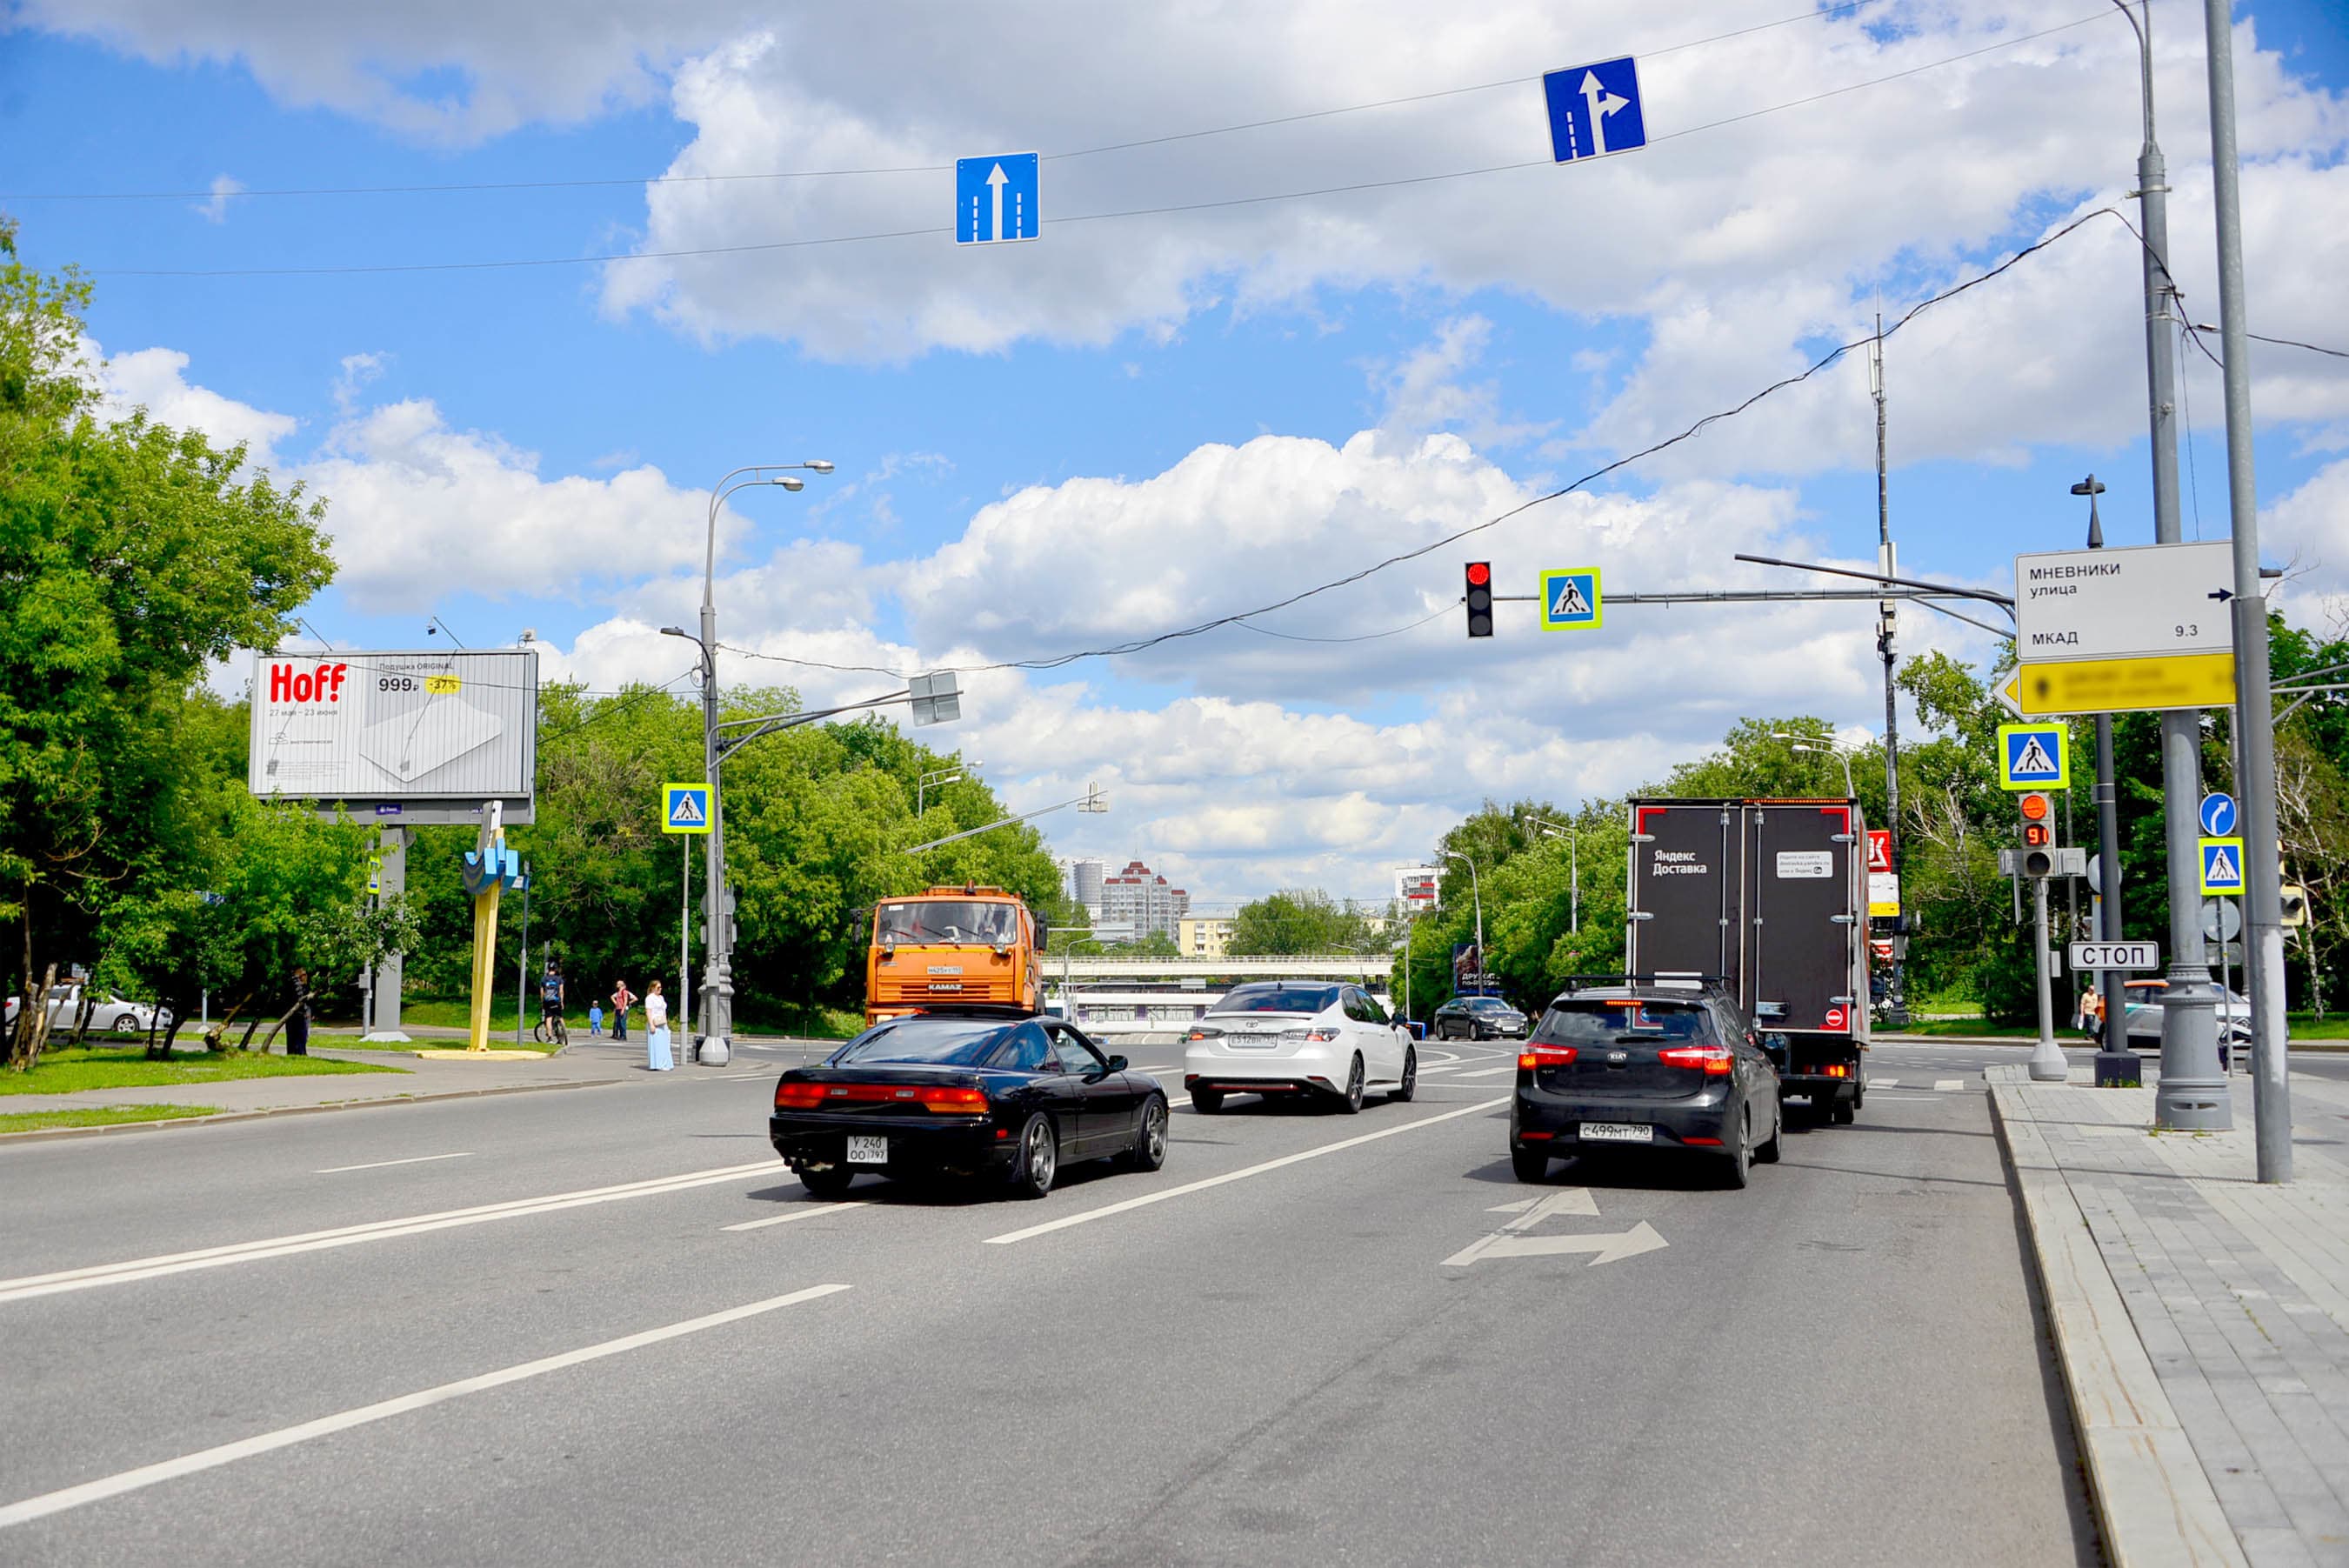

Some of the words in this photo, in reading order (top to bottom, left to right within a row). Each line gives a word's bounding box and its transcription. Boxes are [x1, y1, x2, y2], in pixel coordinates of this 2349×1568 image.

[2030, 564, 2121, 580] МНЕВНИКИ
[2030, 585, 2078, 599] улица
[2032, 631, 2079, 645] МКАД
[2174, 624, 2199, 637] 9.3
[1654, 849, 1696, 863] Яндекс
[1652, 863, 1707, 877] Доставка
[2082, 947, 2145, 964] СТОП
